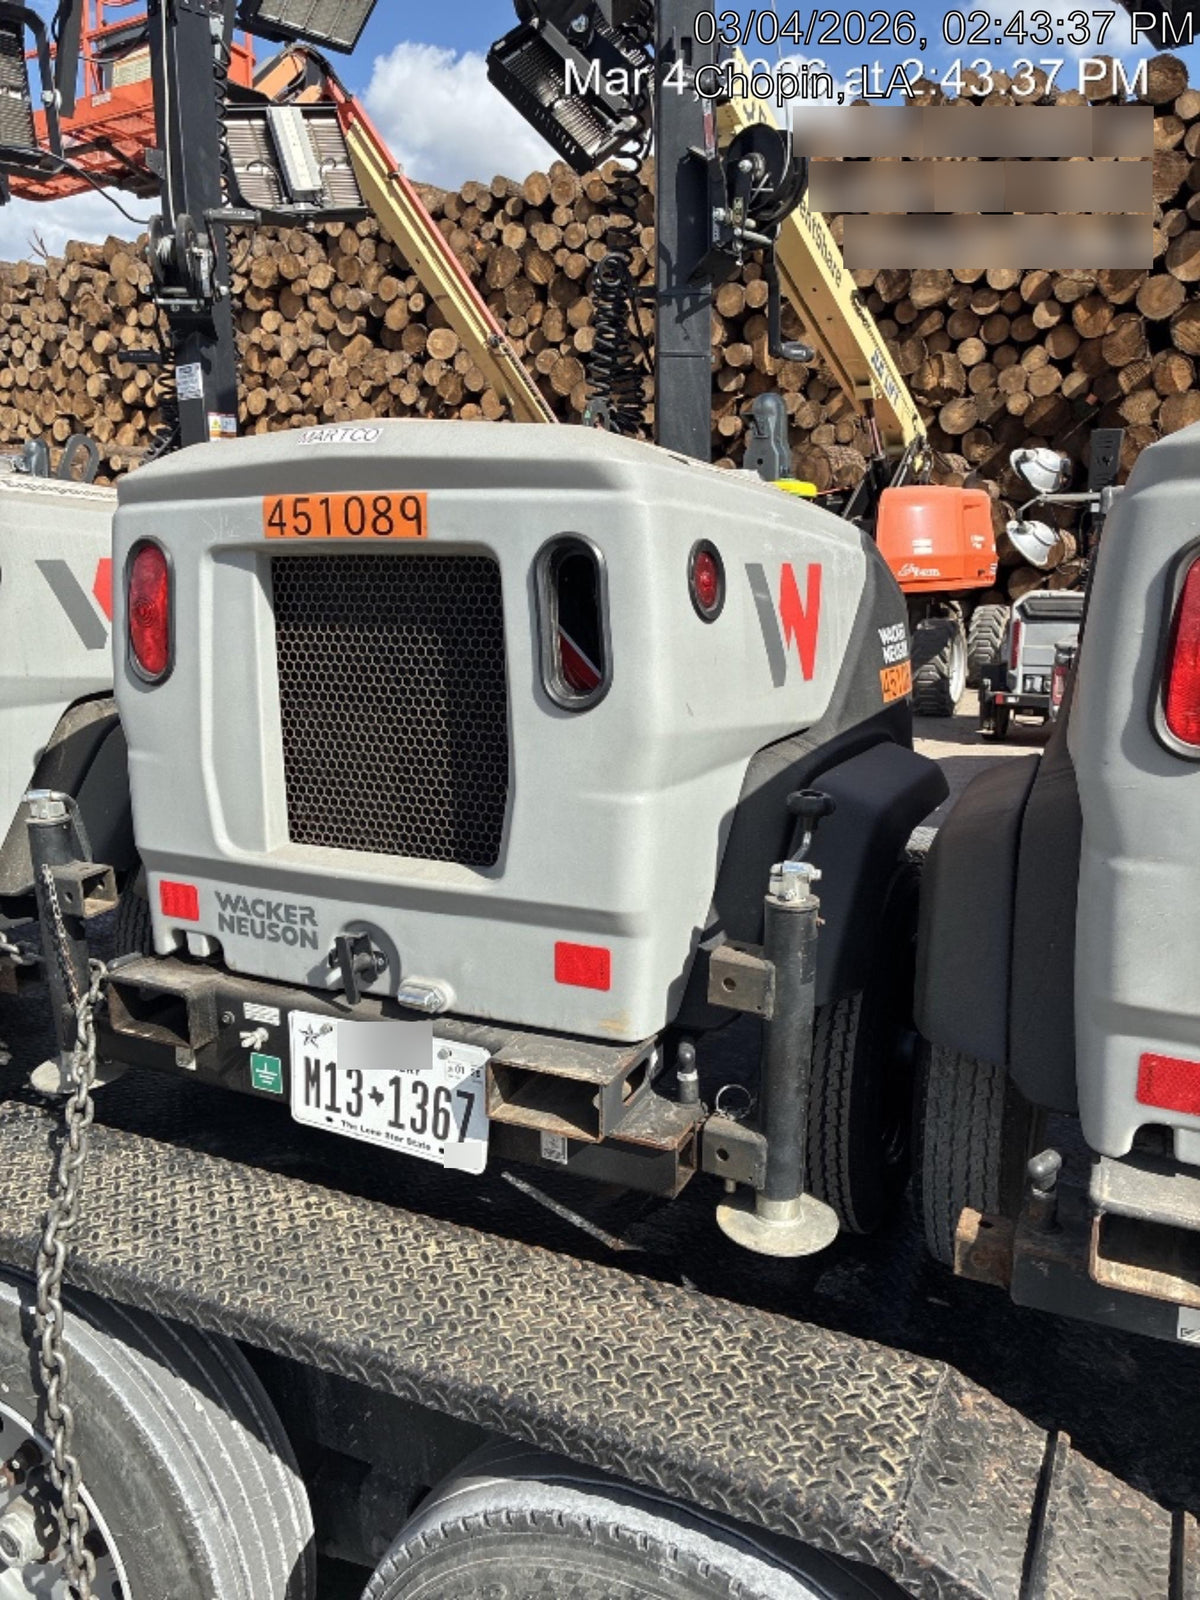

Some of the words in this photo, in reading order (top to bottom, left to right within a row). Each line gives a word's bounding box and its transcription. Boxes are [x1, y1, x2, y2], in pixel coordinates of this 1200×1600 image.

[799, 201, 842, 288] entShare
[268, 495, 423, 536] 451089
[214, 890, 318, 927] WACKER
[217, 912, 319, 950] NEUSON
[385, 1131, 404, 1143] Star
[406, 1137, 431, 1151] State
